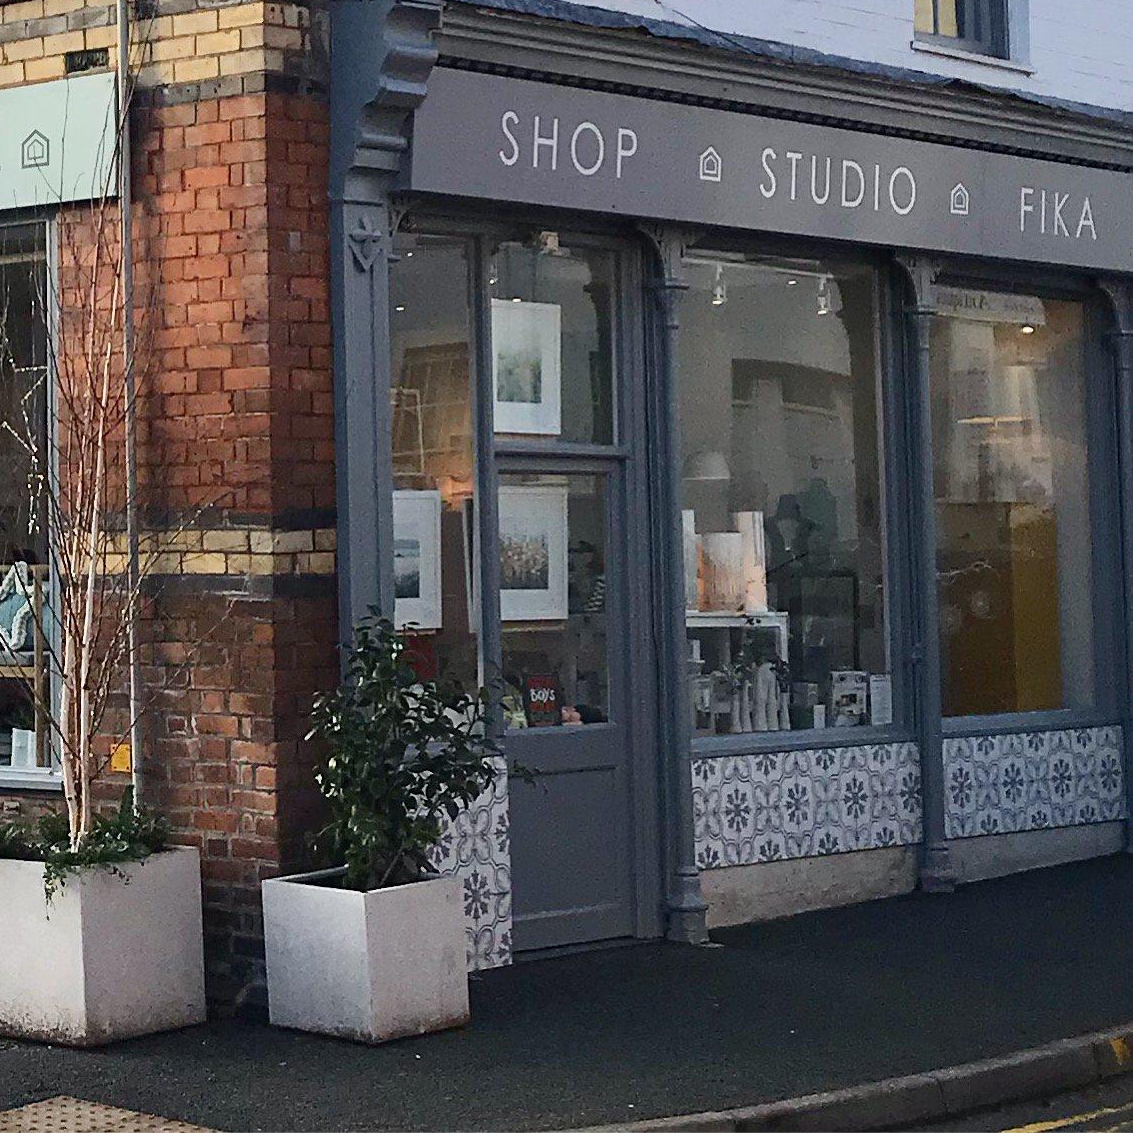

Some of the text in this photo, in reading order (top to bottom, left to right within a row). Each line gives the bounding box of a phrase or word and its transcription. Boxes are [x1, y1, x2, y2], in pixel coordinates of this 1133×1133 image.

[499, 110, 1097, 241] SHOP STUDIO FIKA
